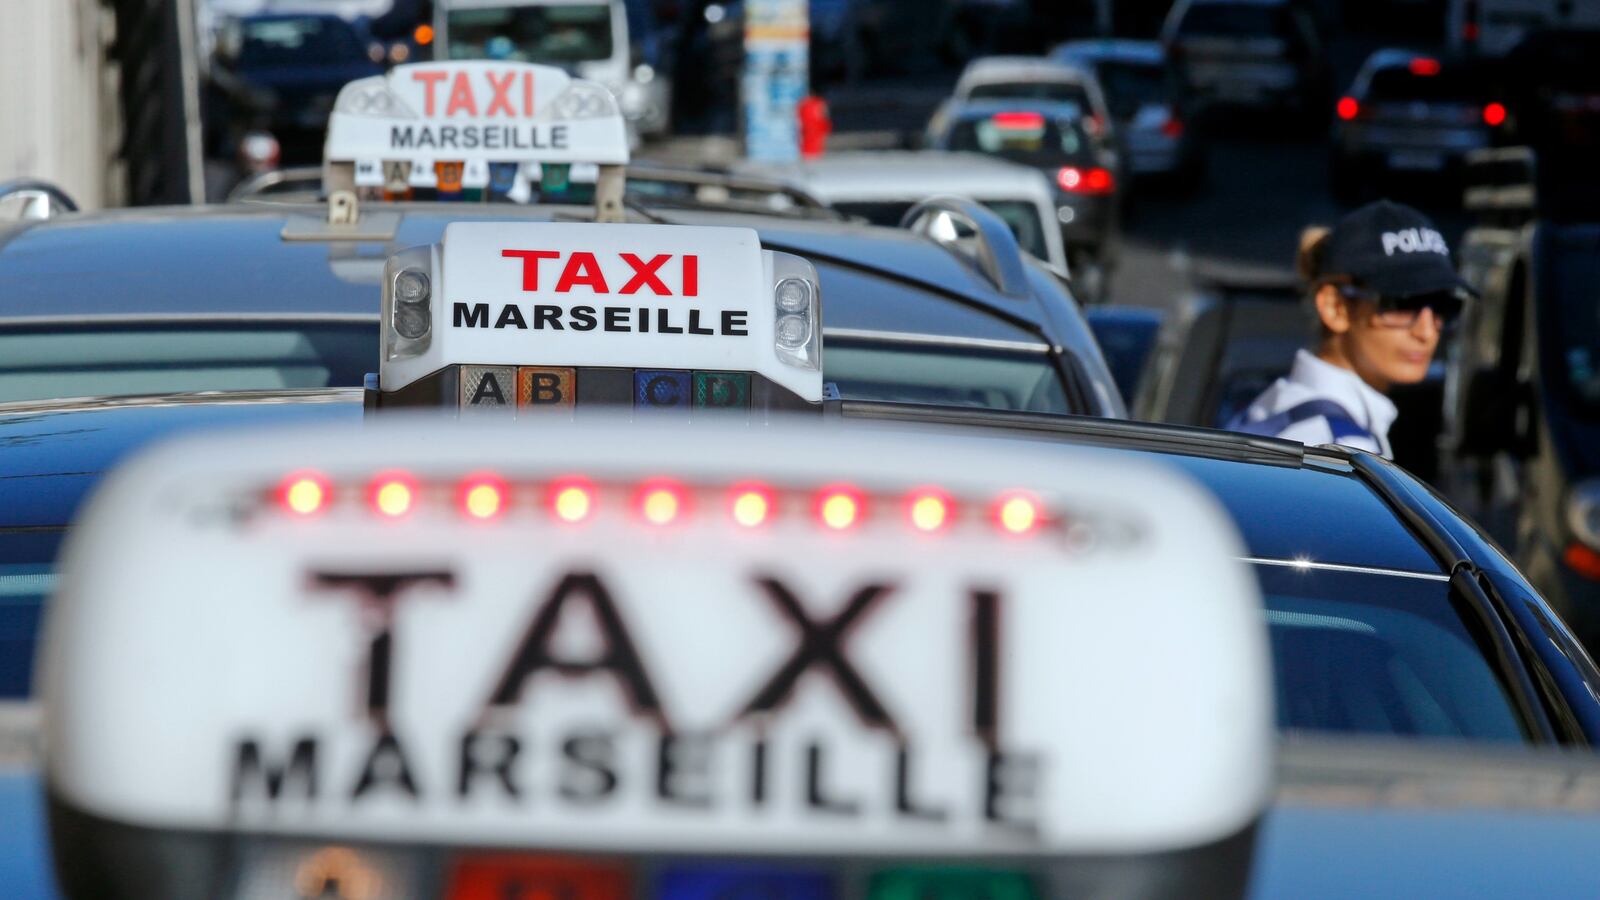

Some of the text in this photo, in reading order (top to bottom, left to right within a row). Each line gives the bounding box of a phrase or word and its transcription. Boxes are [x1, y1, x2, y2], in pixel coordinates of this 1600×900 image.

[411, 70, 535, 118] TAXI
[390, 125, 569, 149] MARSEILLE
[501, 249, 698, 297] TAXI
[452, 302, 749, 336] MARSEILLE
[471, 372, 738, 406] A B C D
[304, 566, 1008, 748] TAXI
[229, 730, 1046, 838] MARSEILLE
